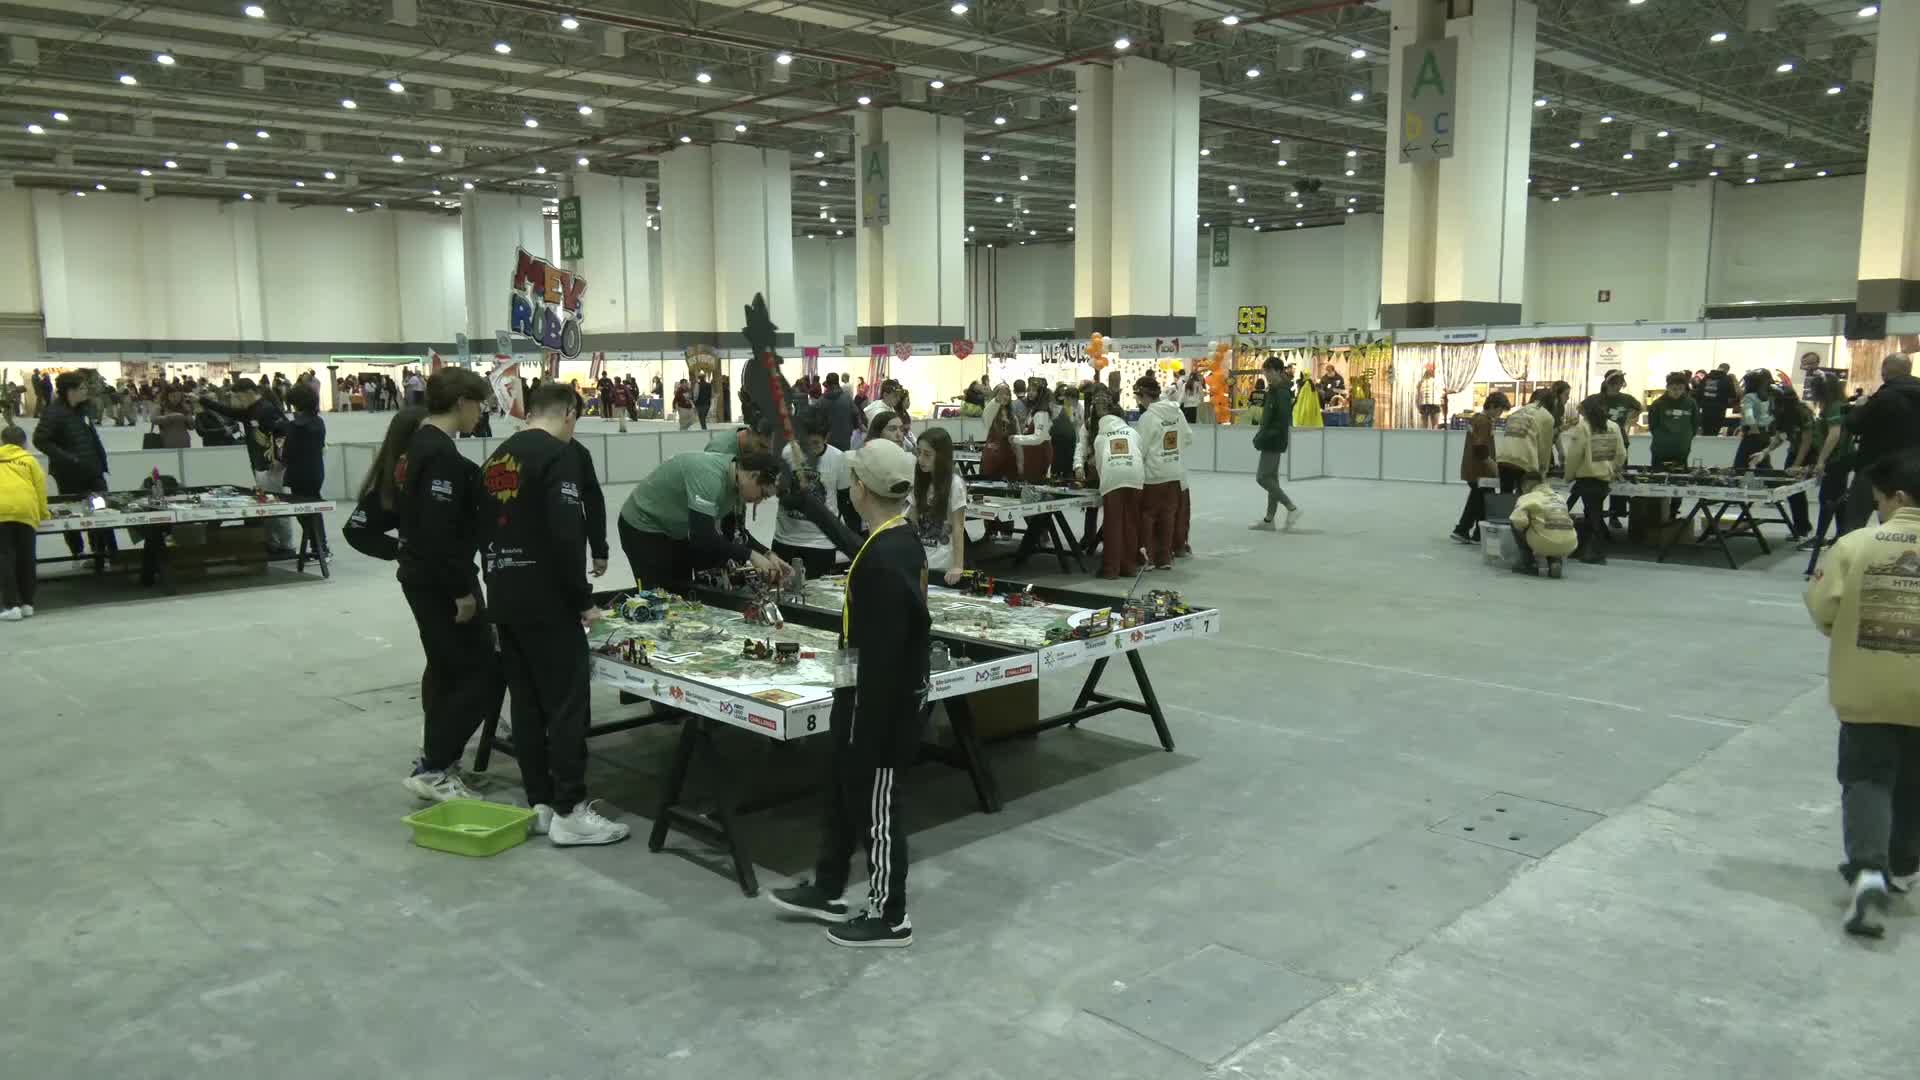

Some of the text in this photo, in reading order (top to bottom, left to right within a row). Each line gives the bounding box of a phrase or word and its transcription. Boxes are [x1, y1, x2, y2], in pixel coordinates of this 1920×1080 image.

[1411, 49, 1445, 99] A
[1406, 112, 1449, 139] D C
[868, 151, 884, 184] A
[513, 248, 587, 312] MEV
[511, 293, 581, 358] ROBO
[1041, 341, 1090, 364] NEXUR
[1893, 579, 1920, 589] HTM
[1203, 620, 1209, 632] 7
[806, 714, 816, 731] 8
